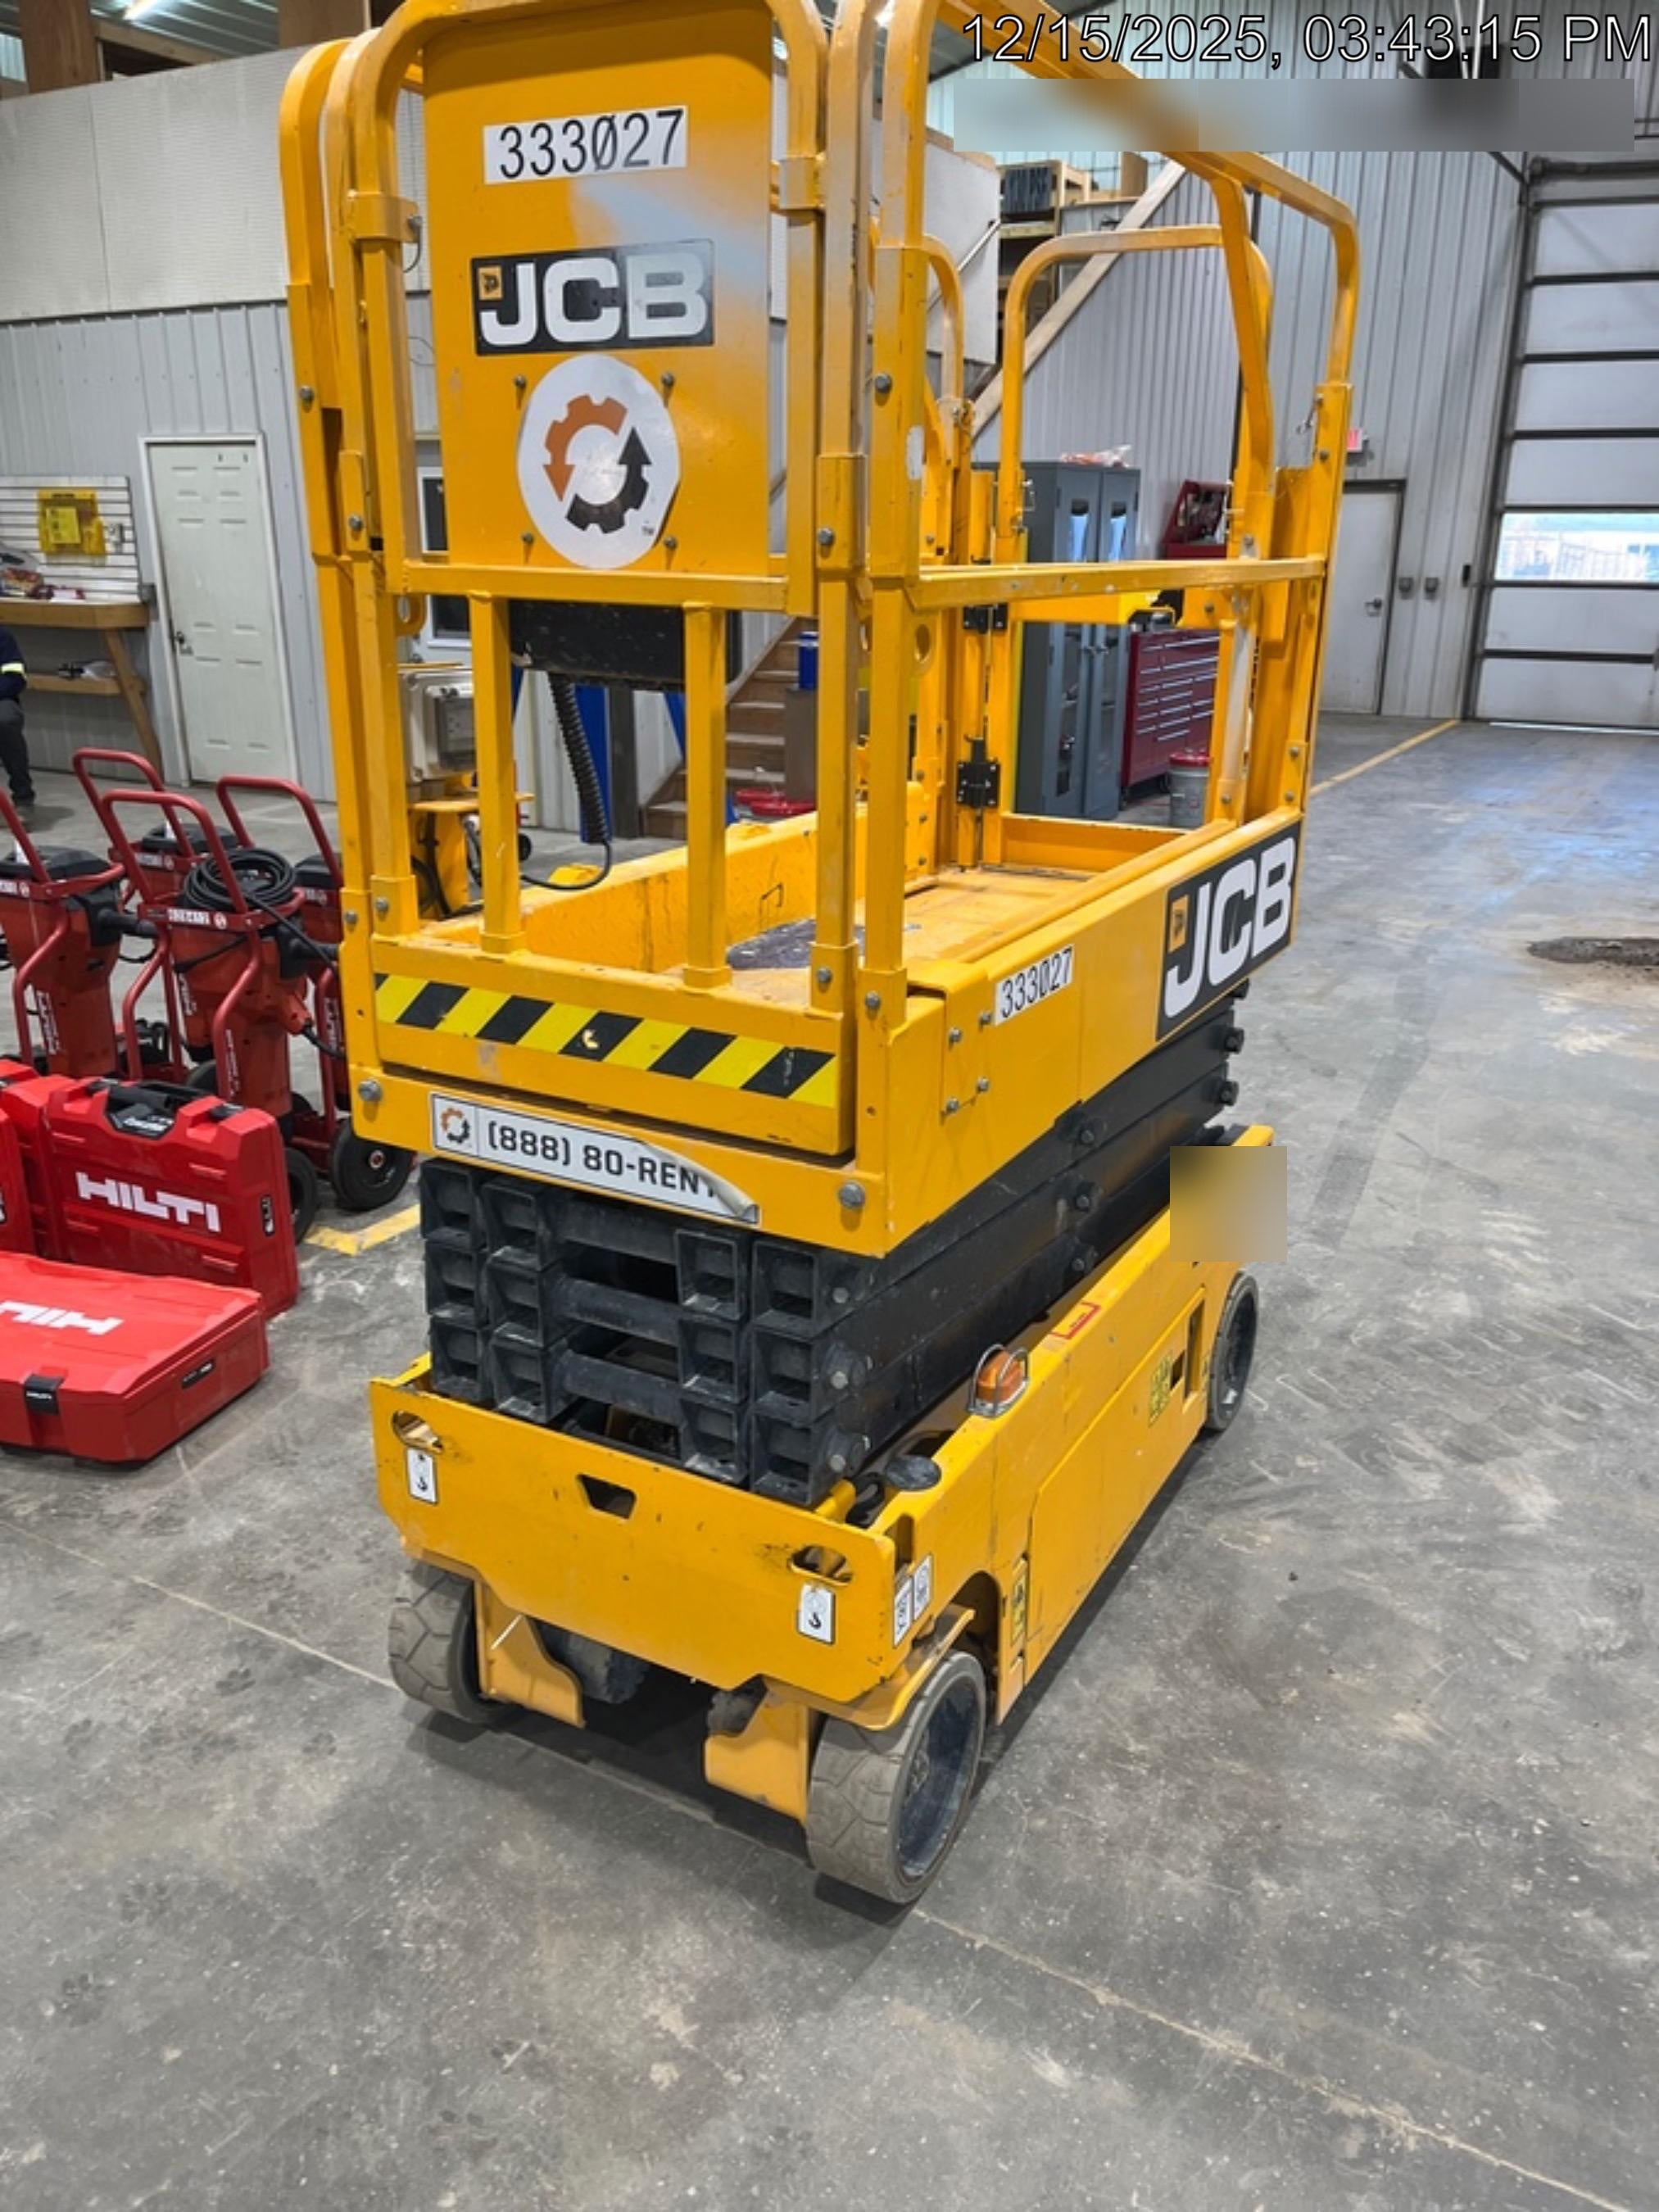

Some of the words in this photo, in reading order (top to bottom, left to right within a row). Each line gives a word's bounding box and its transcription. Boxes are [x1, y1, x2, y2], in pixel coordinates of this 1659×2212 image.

[500, 108, 683, 179] 333027
[480, 252, 708, 347] JCB
[1164, 837, 1295, 1018] JCB
[1001, 946, 1072, 1018] 333027
[487, 1120, 571, 1167] (888)
[75, 1172, 221, 1232] HILTI
[0, 1300, 125, 1336] HIL
